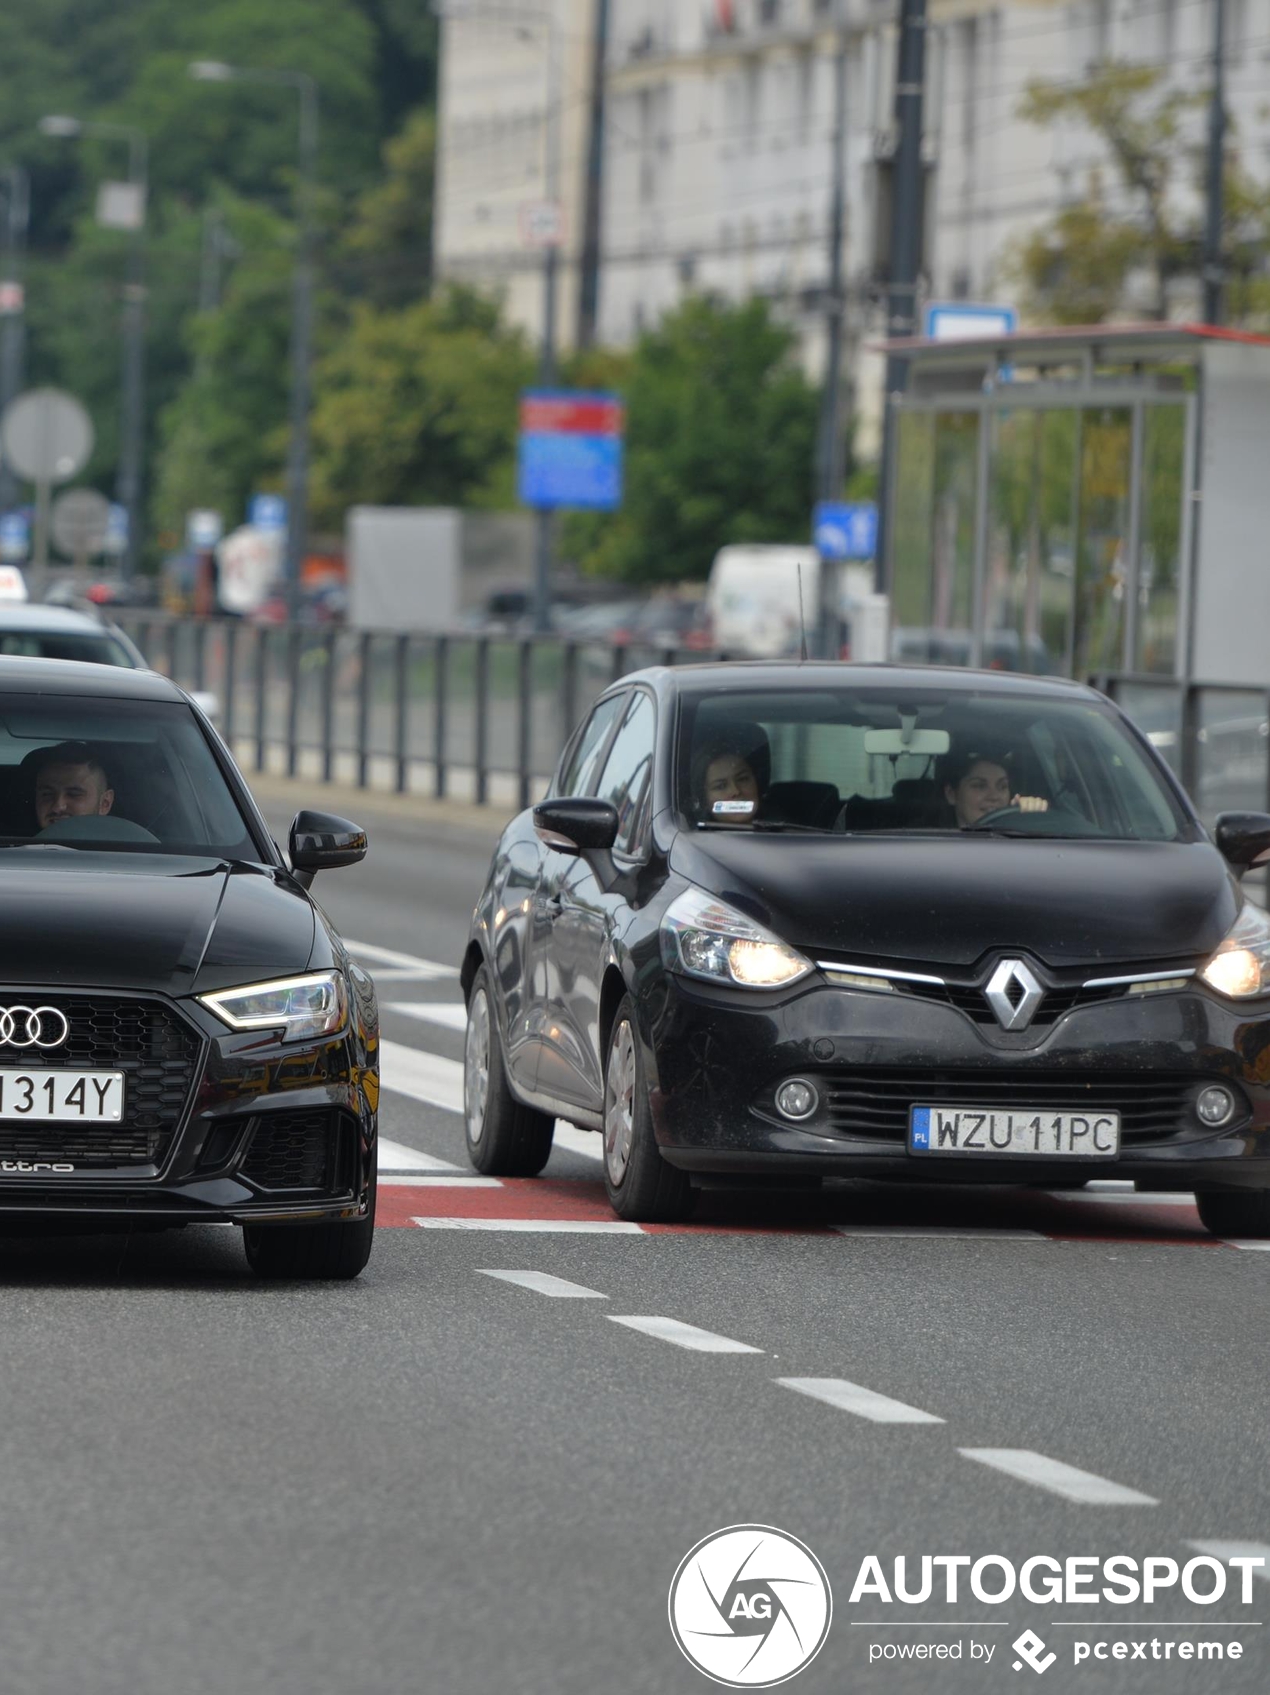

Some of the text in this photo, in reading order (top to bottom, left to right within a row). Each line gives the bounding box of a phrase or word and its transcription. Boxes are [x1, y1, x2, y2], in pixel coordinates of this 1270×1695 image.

[914, 1132, 928, 1143] PL
[936, 1112, 1113, 1152] WZU 11PC
